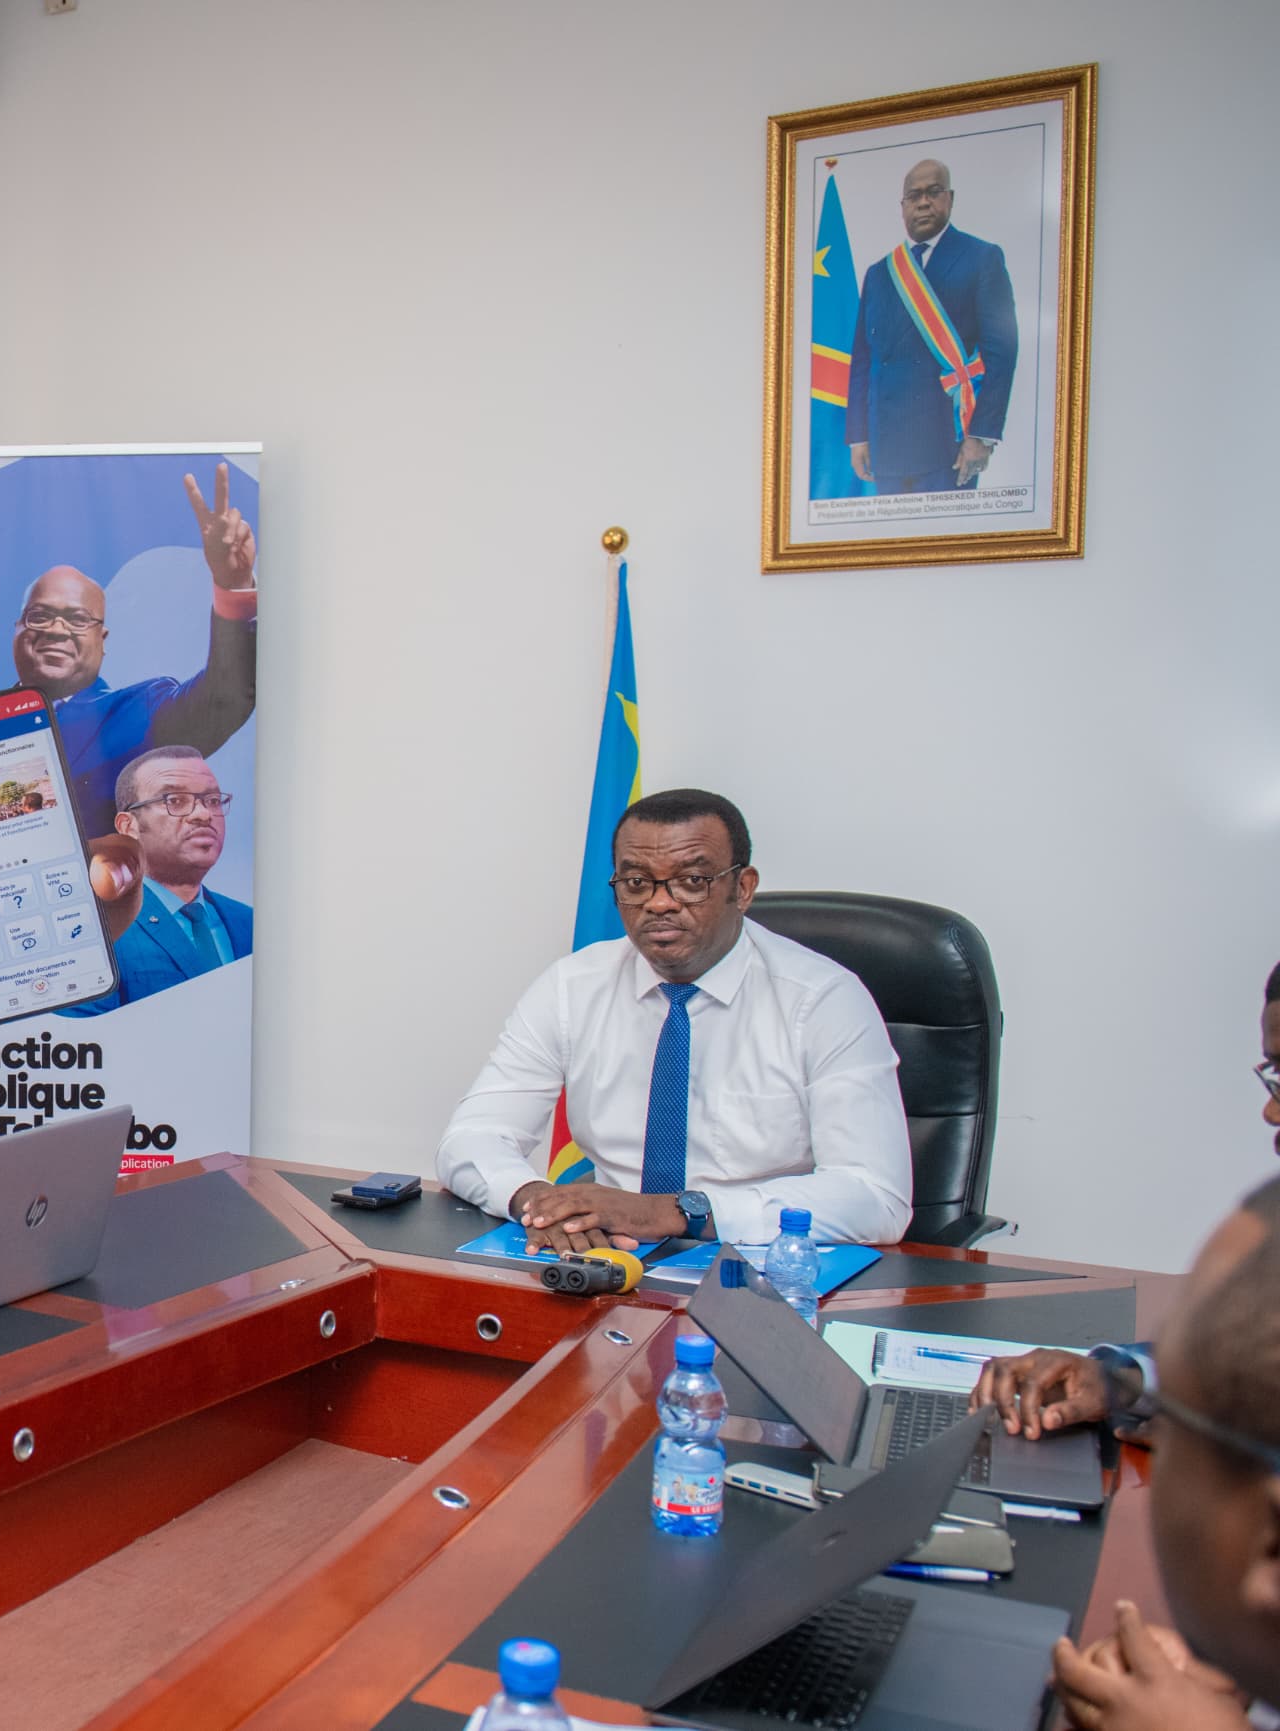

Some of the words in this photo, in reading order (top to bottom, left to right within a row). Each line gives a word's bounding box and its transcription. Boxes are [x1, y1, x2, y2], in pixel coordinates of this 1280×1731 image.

[926, 491, 975, 501] TSHISEKEDI
[978, 488, 1028, 499] TSHILOMBO
[924, 502, 980, 513] Démocratique
[982, 501, 993, 509] du
[995, 499, 1024, 510] Congo
[120, 1158, 170, 1171] plication
